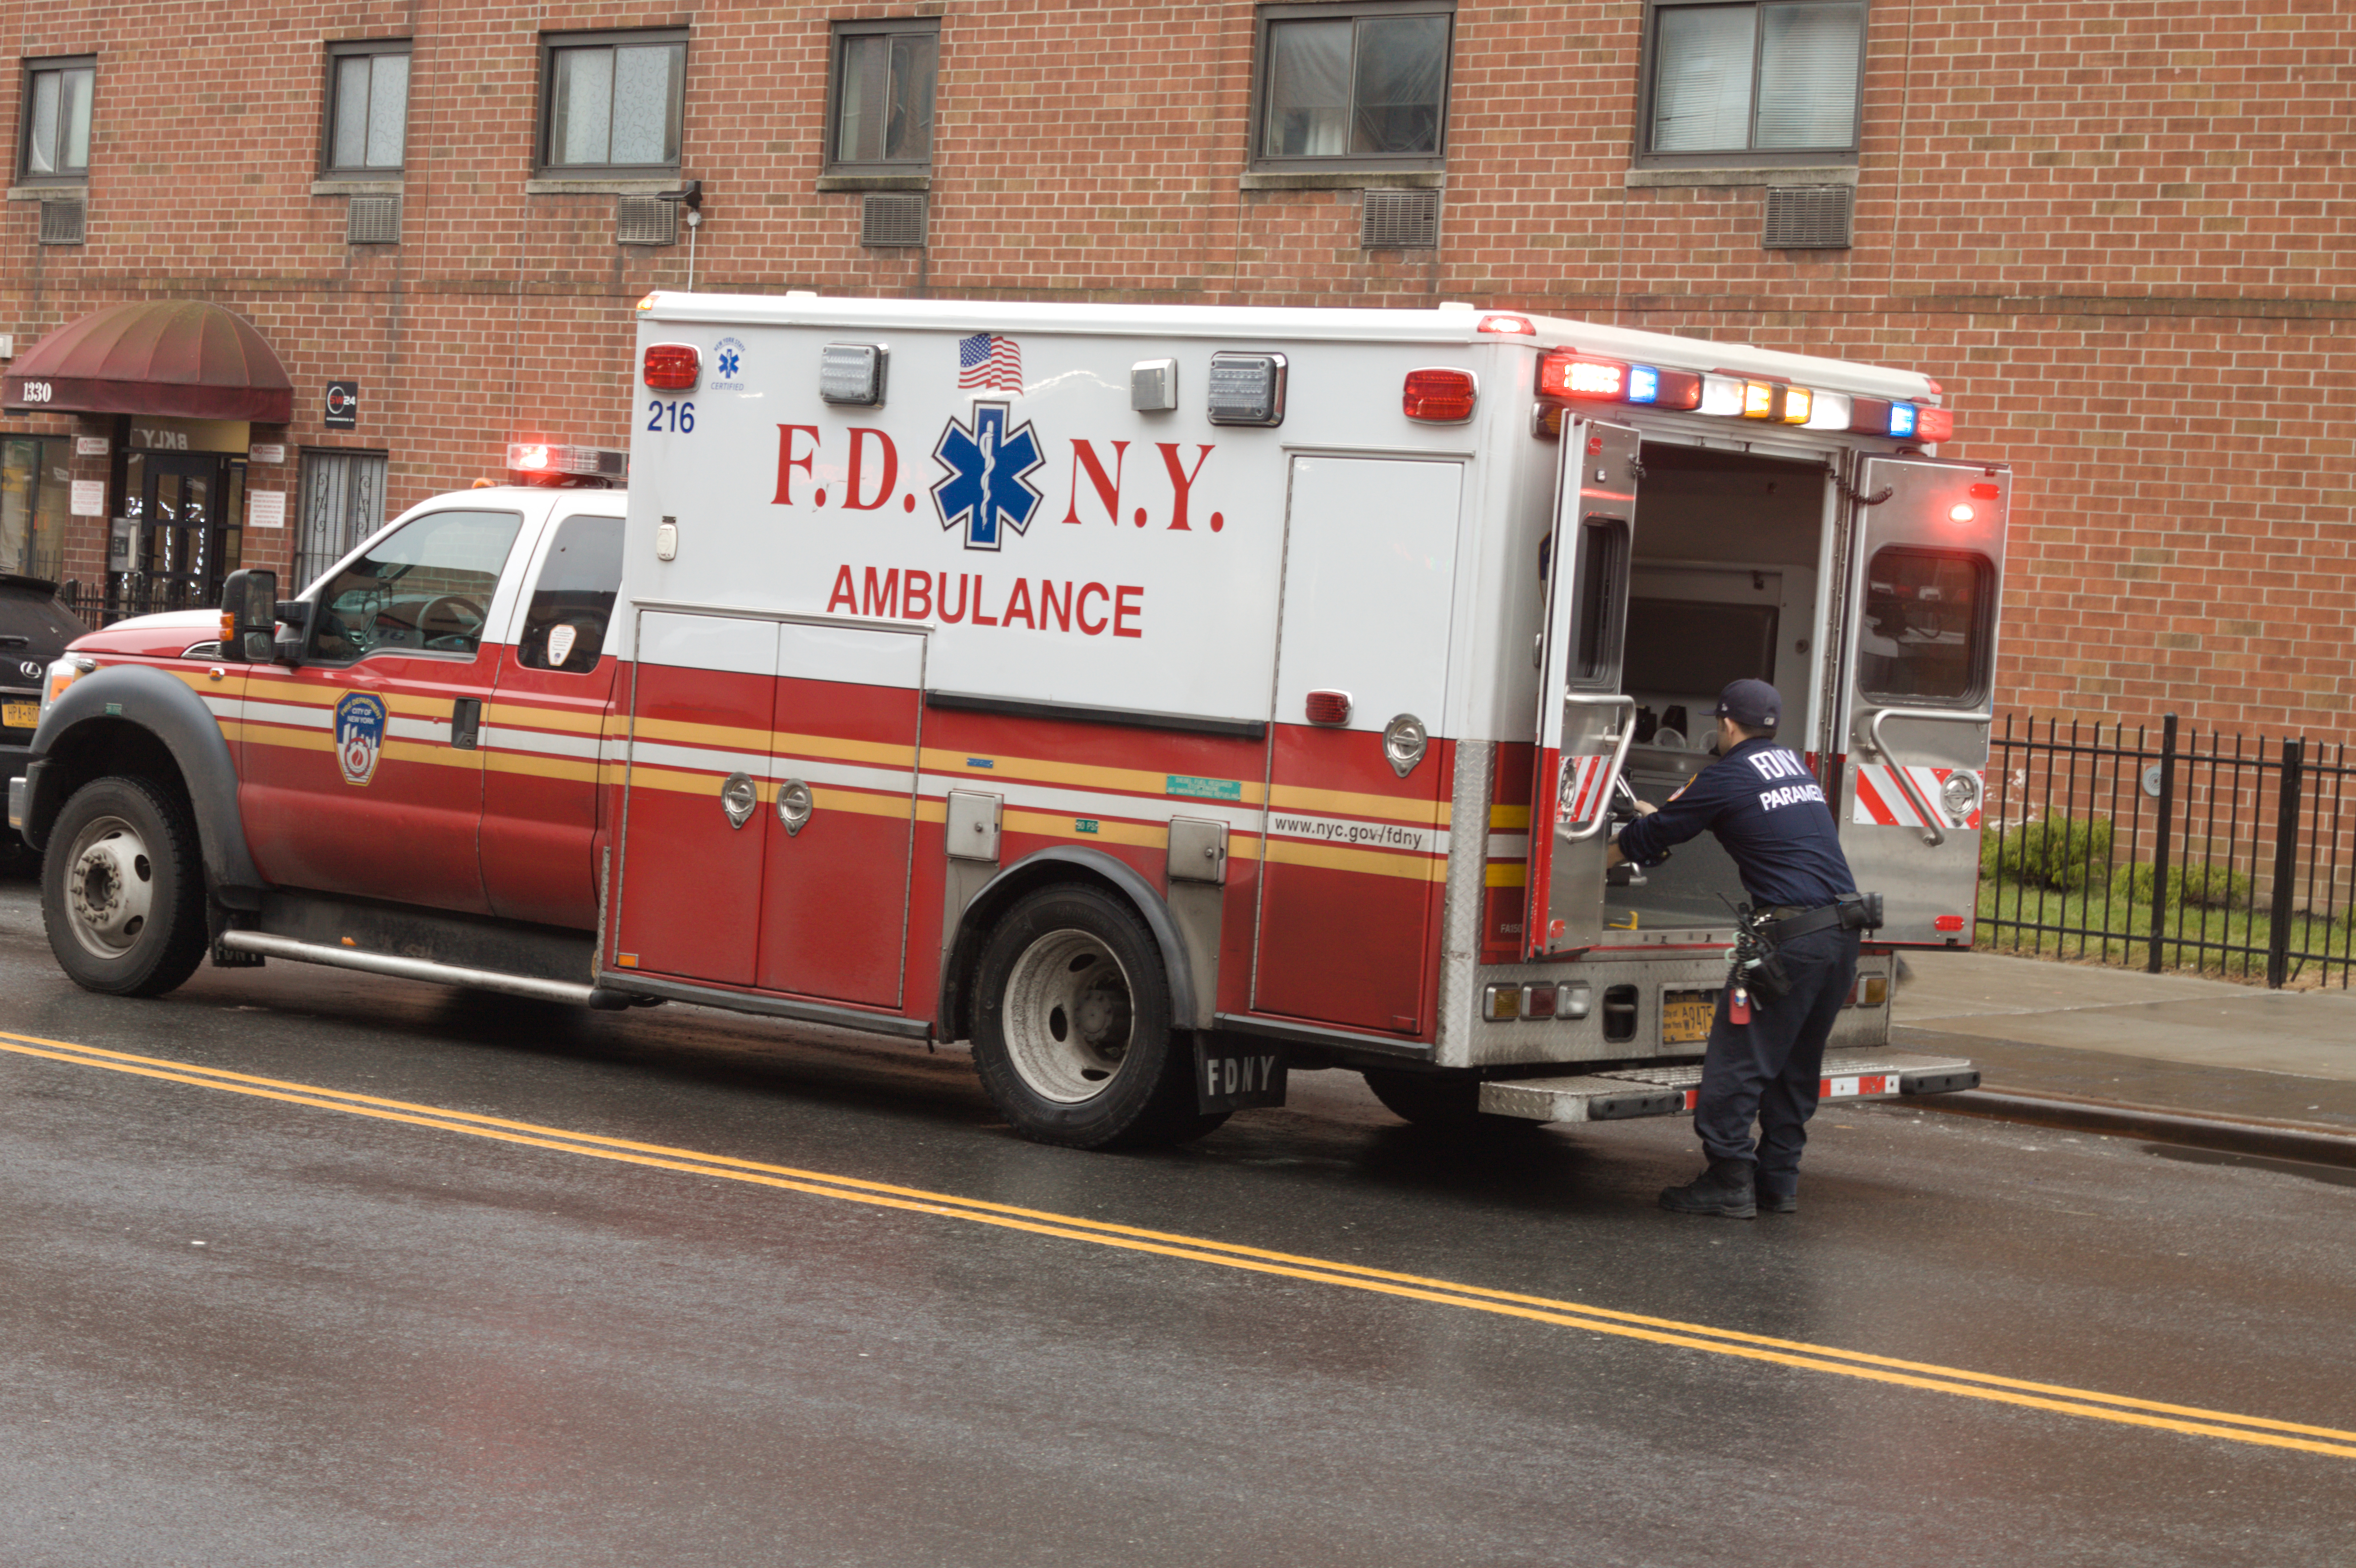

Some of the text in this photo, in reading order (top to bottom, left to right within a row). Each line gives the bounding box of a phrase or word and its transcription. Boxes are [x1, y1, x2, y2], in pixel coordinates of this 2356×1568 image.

[714, 340, 722, 352] NEW
[735, 339, 746, 352] STATE
[23, 381, 51, 402] 1330
[711, 382, 744, 391] CERTIFIED
[647, 401, 695, 434] 216
[79, 440, 88, 451] NO
[771, 423, 1224, 532] F.D. N.Y.
[826, 564, 1144, 638] AMBULANCE
[340, 697, 382, 719] FIRE DEPARTMENT
[1747, 749, 1806, 780] FDNY
[1759, 784, 1824, 811] PARAMED
[1275, 818, 1422, 850] www.nyc.gov/fdny
[1207, 1056, 1275, 1096] FDNY
